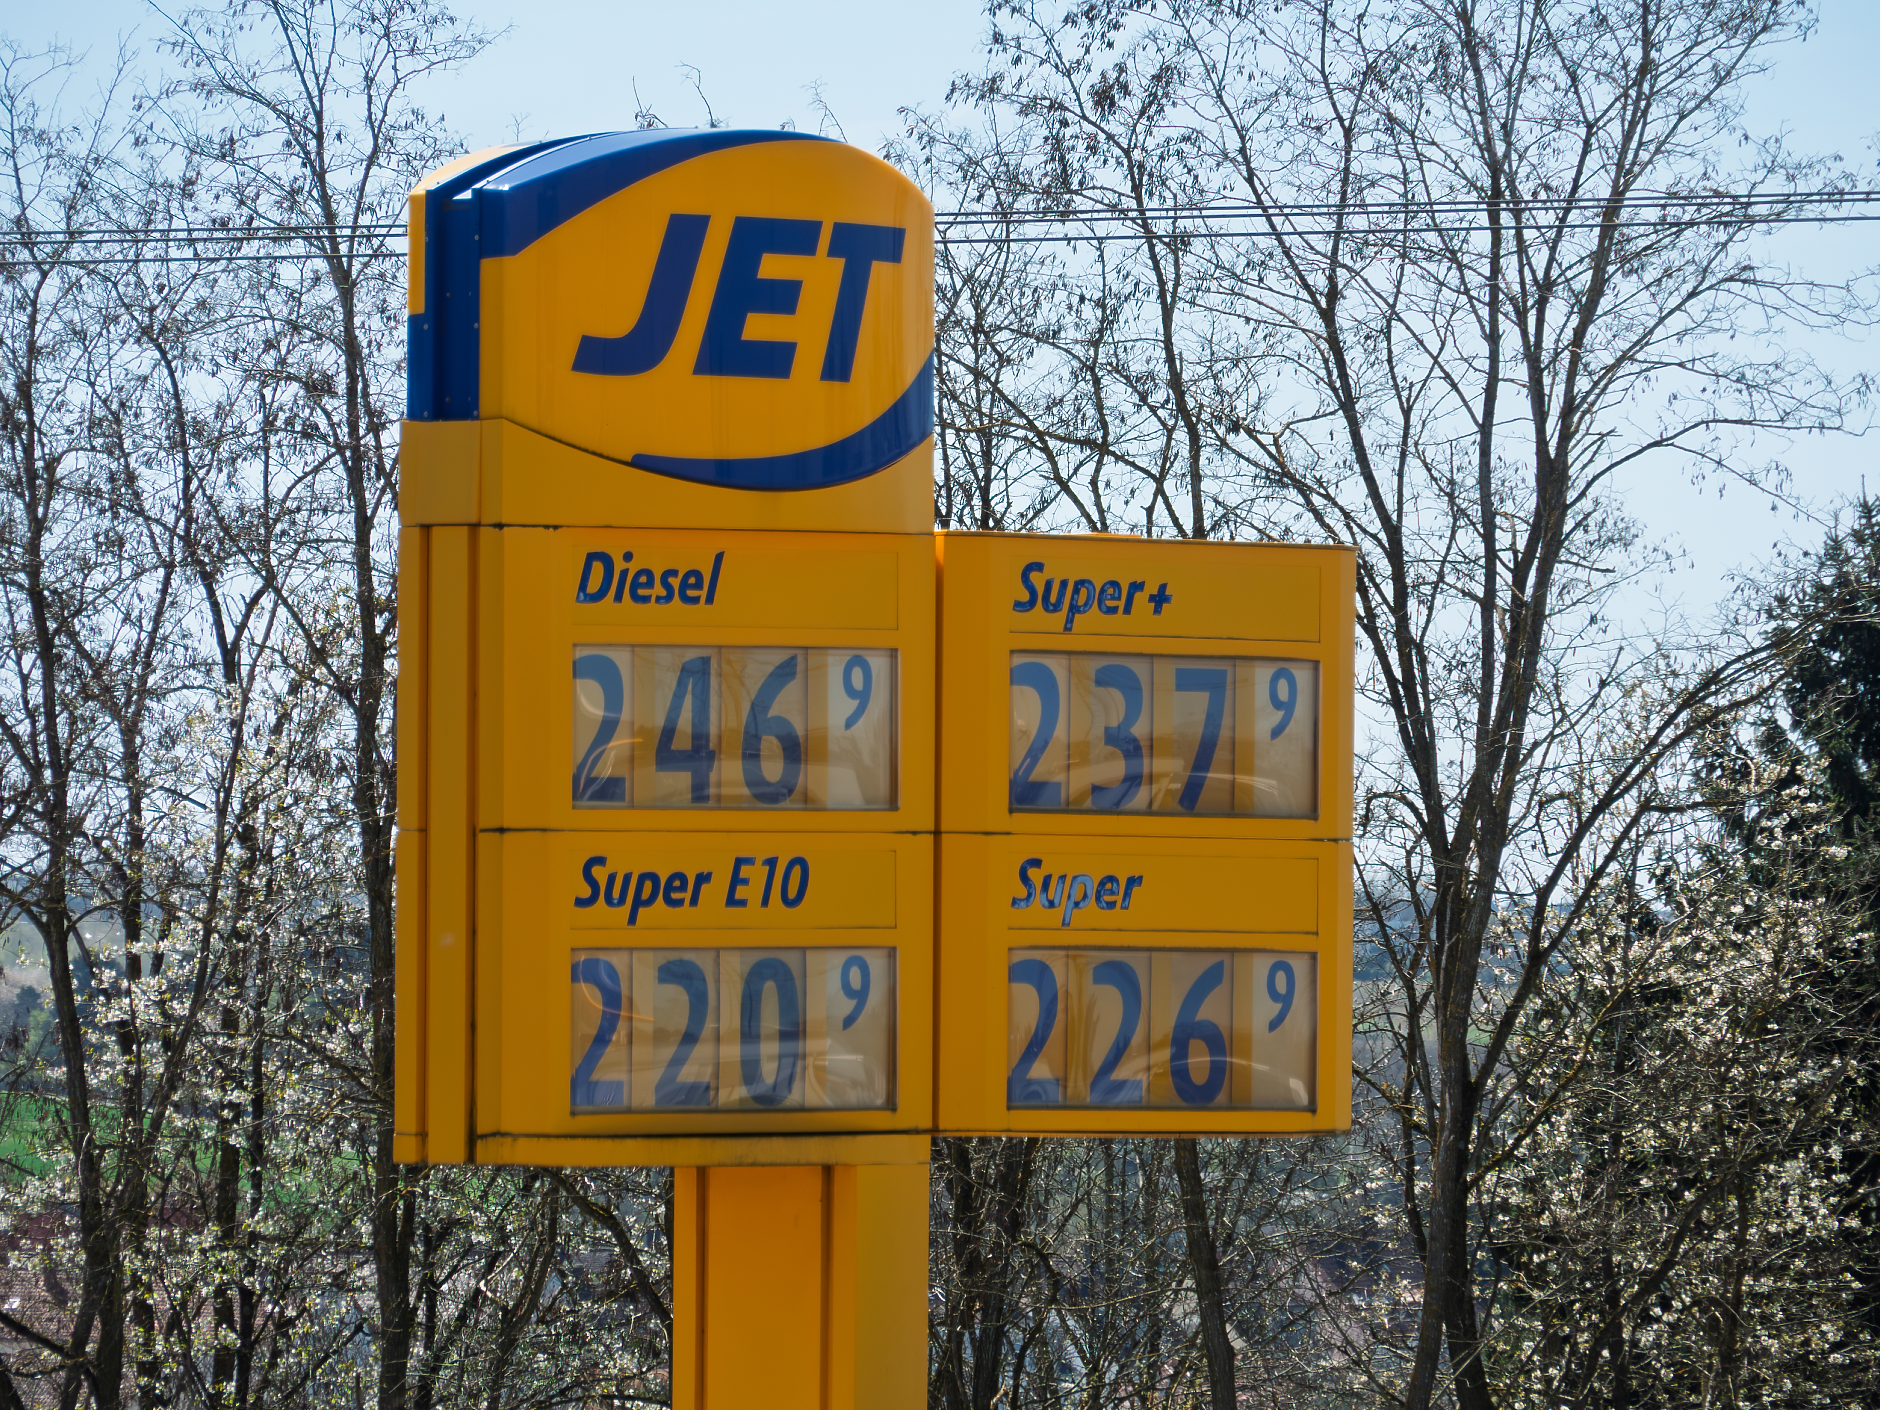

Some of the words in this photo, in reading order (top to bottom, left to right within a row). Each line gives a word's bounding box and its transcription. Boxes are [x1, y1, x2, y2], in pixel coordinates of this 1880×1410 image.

[571, 213, 906, 383] JET
[575, 551, 725, 605] Diesel
[1012, 561, 1173, 632] Super+
[573, 855, 713, 926] Super
[724, 855, 810, 908] E10
[1011, 858, 1143, 927] Super
